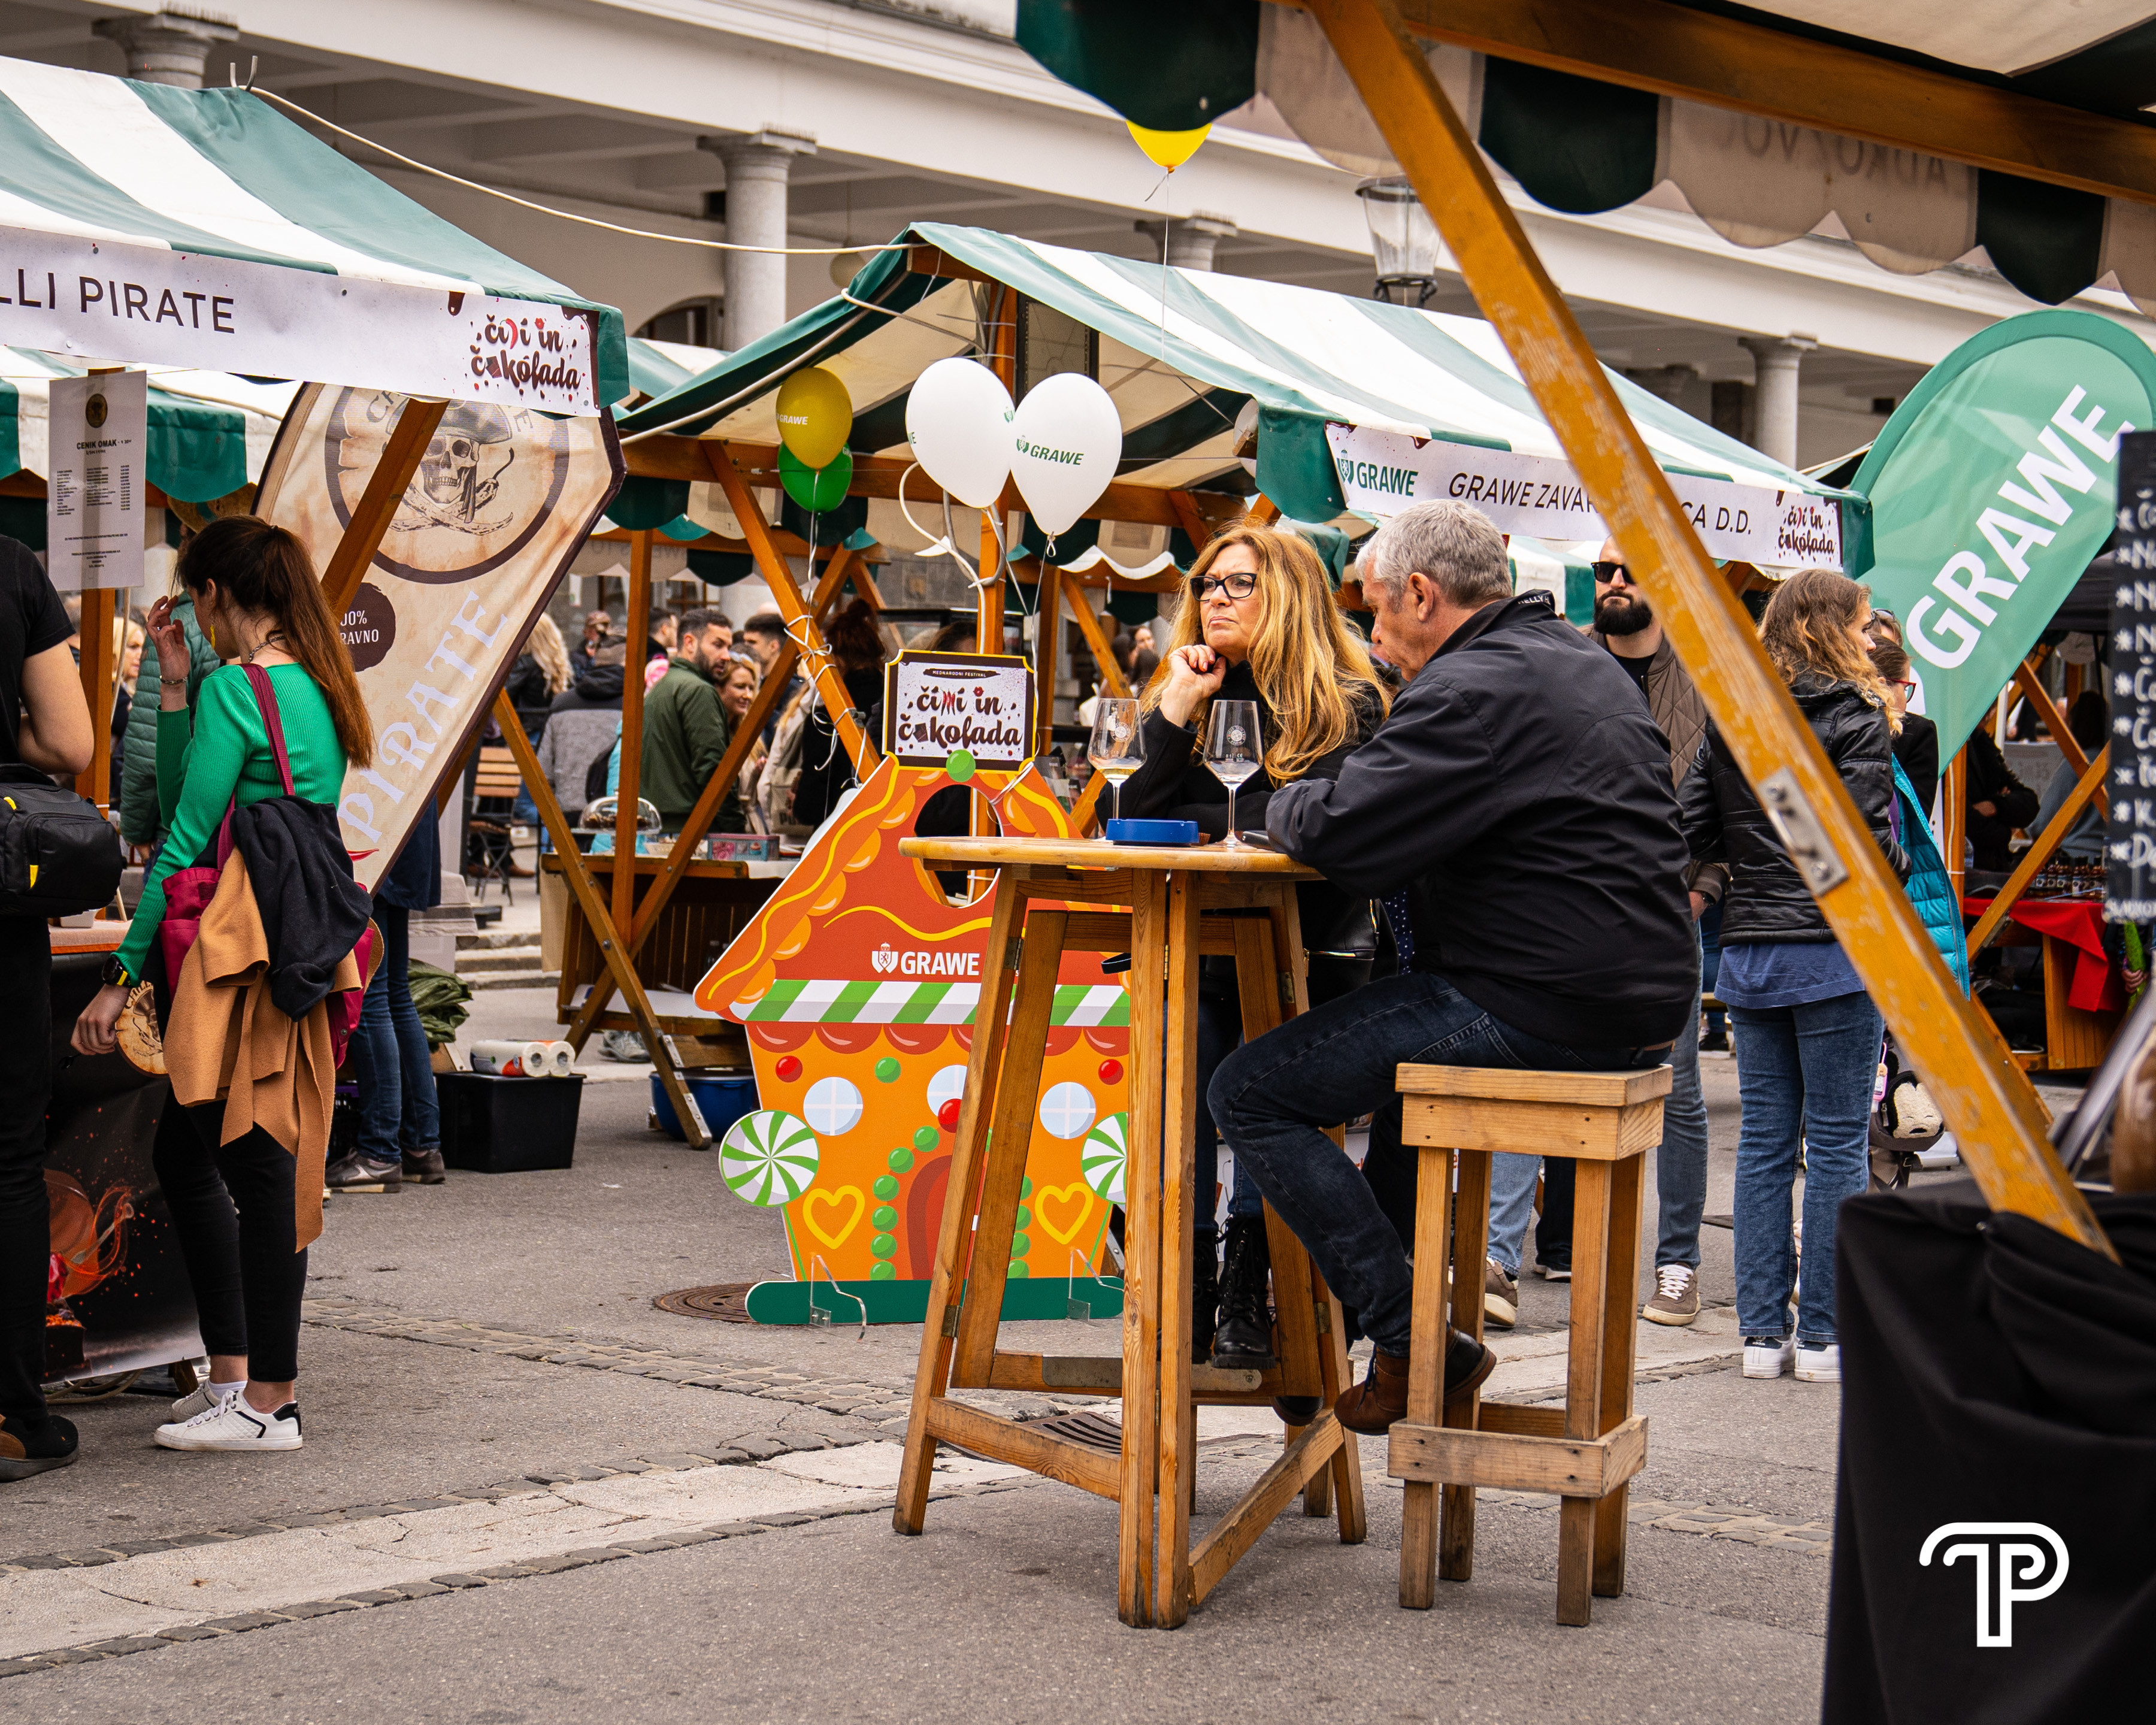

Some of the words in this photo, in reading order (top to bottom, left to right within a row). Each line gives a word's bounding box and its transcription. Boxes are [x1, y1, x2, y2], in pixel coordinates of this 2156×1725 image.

[79, 276, 235, 334] PIRATE
[534, 317, 564, 352] in
[779, 414, 808, 425] GRAWE
[77, 441, 96, 449] CENIK
[1030, 445, 1084, 466] GRAWE
[1356, 462, 1419, 497] GRAWE
[1449, 472, 1534, 507] GRAWE
[1715, 507, 1751, 535] D.D.
[1810, 506, 1824, 529] in
[1906, 384, 2136, 669] GRAWE
[973, 686, 1004, 715] in
[337, 591, 508, 843] PIRATE
[900, 951, 980, 976] GRAWE
